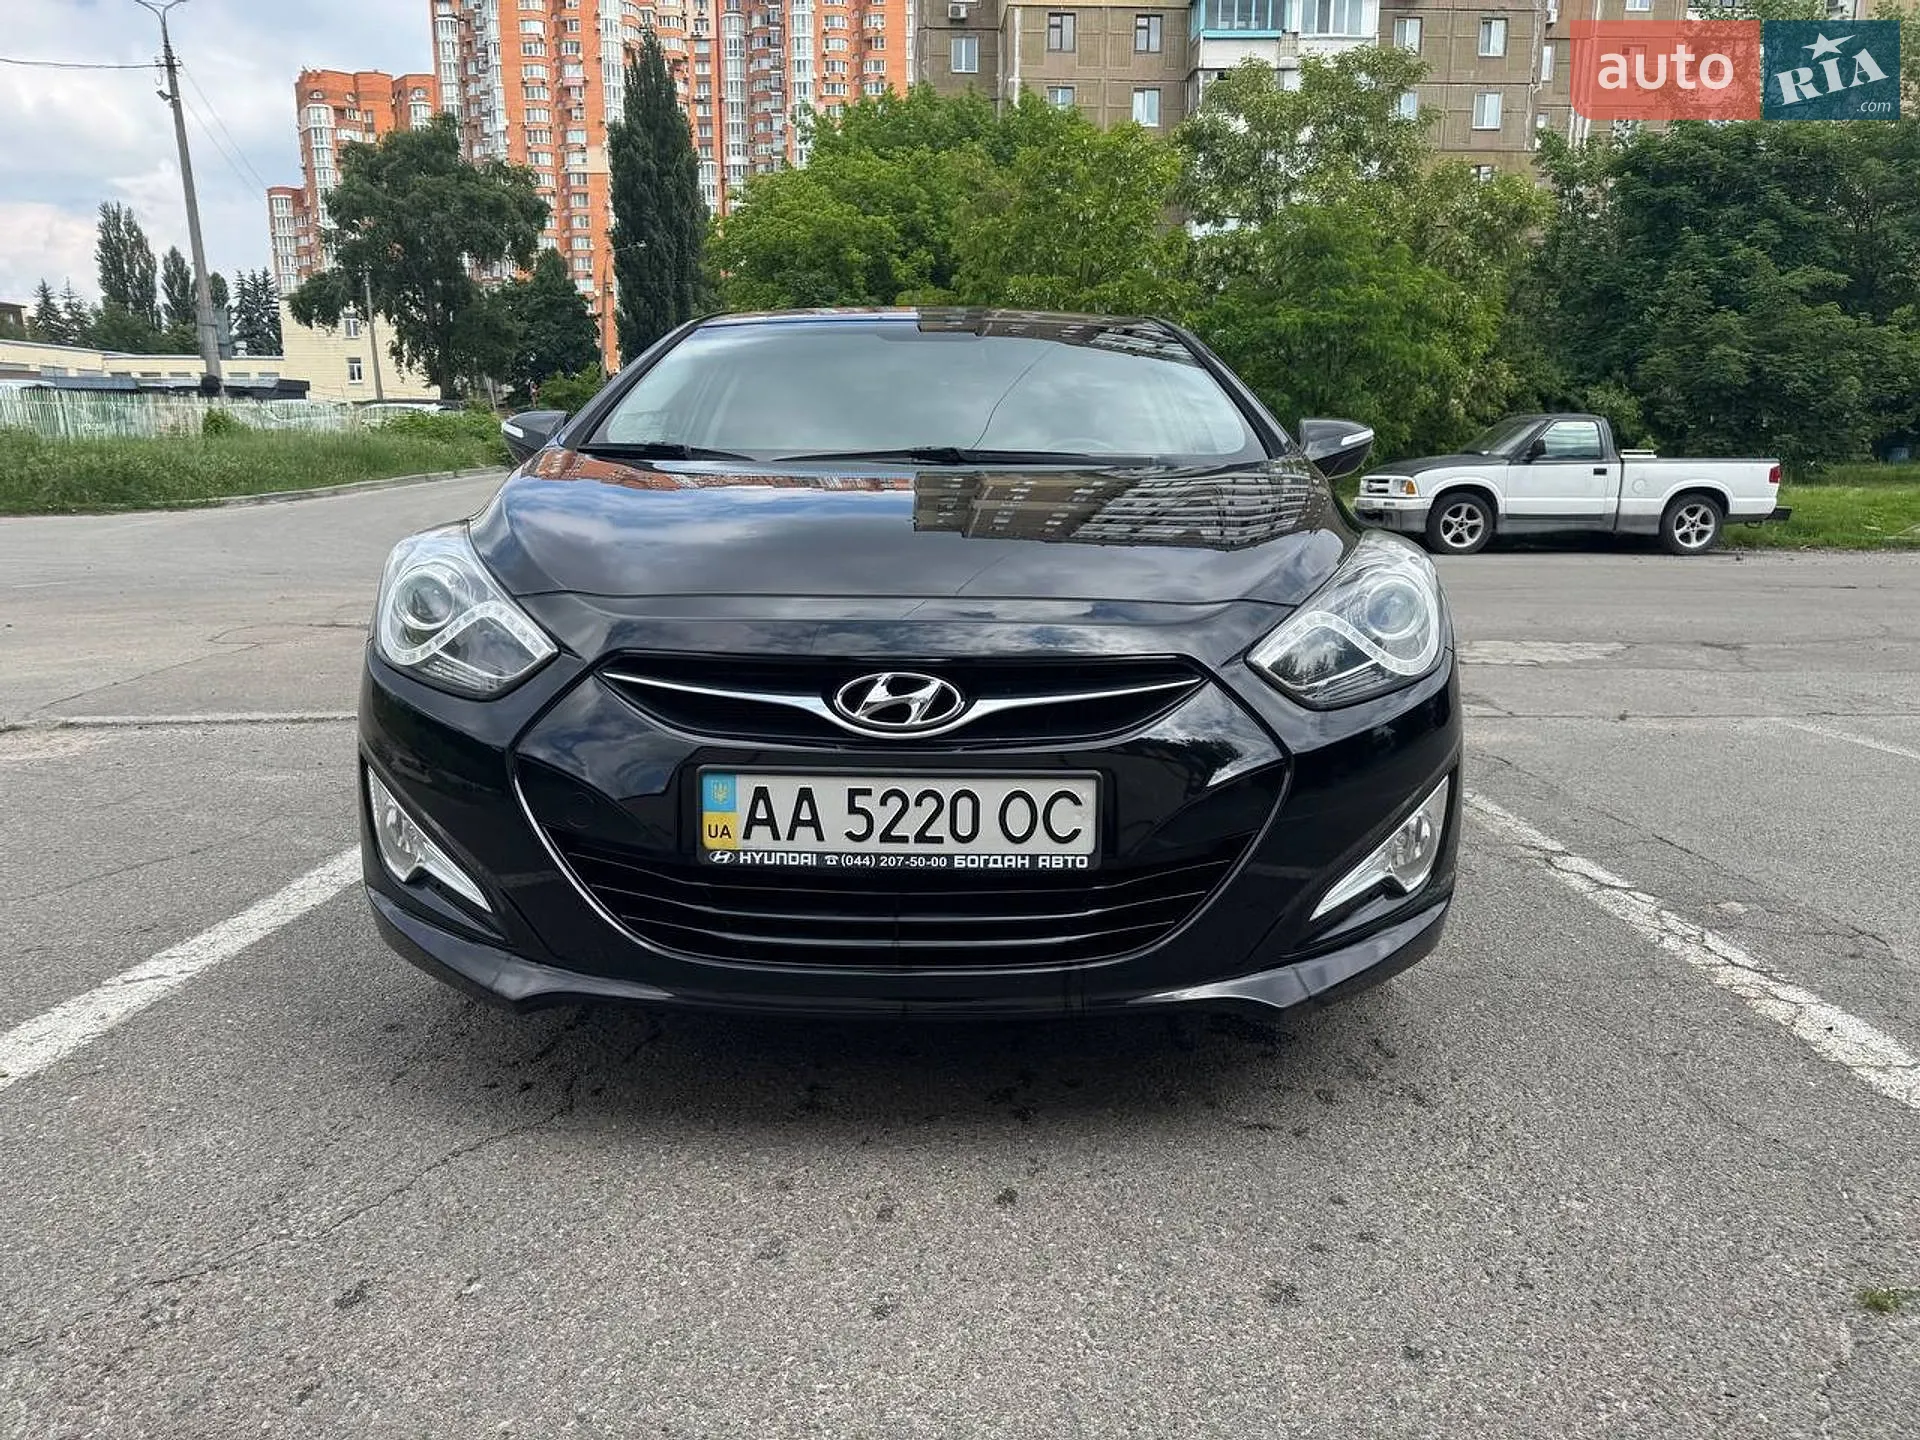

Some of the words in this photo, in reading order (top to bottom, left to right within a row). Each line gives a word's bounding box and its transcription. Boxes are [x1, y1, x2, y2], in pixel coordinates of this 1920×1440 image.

[742, 785, 826, 842] AA
[843, 787, 982, 845] 5220
[999, 788, 1084, 845] OC
[707, 824, 732, 839] UA
[739, 853, 817, 867] HYUNDAI
[840, 855, 876, 868] (044)
[880, 856, 947, 868] 207-50-00
[953, 855, 1030, 869] БОГДАН
[1037, 855, 1089, 869] АВТО
